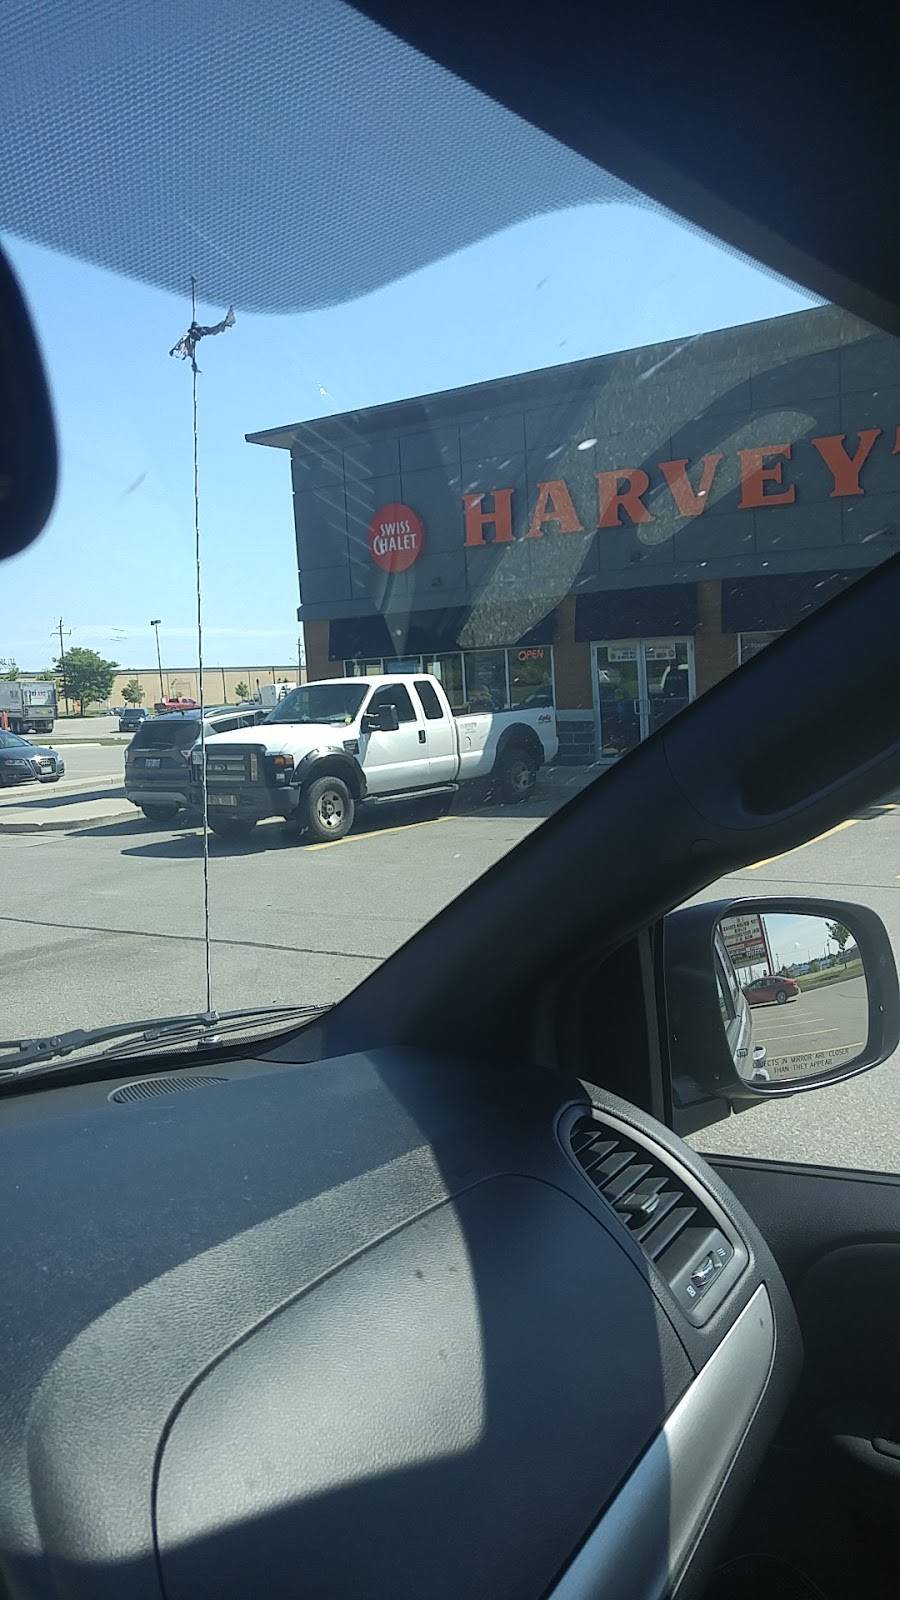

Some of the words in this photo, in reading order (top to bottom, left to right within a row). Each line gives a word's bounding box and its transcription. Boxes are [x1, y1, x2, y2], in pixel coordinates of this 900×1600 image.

[380, 520, 410, 537] SWISS
[373, 533, 416, 556] CHALET
[518, 649, 545, 661] OPEN
[791, 1053, 812, 1063] MIRROR
[815, 1051, 825, 1059] ARE
[828, 1047, 849, 1057] CLOSER
[774, 1066, 789, 1074] THAN
[793, 1062, 807, 1071] THEY
[810, 1058, 833, 1068] APPEAR
